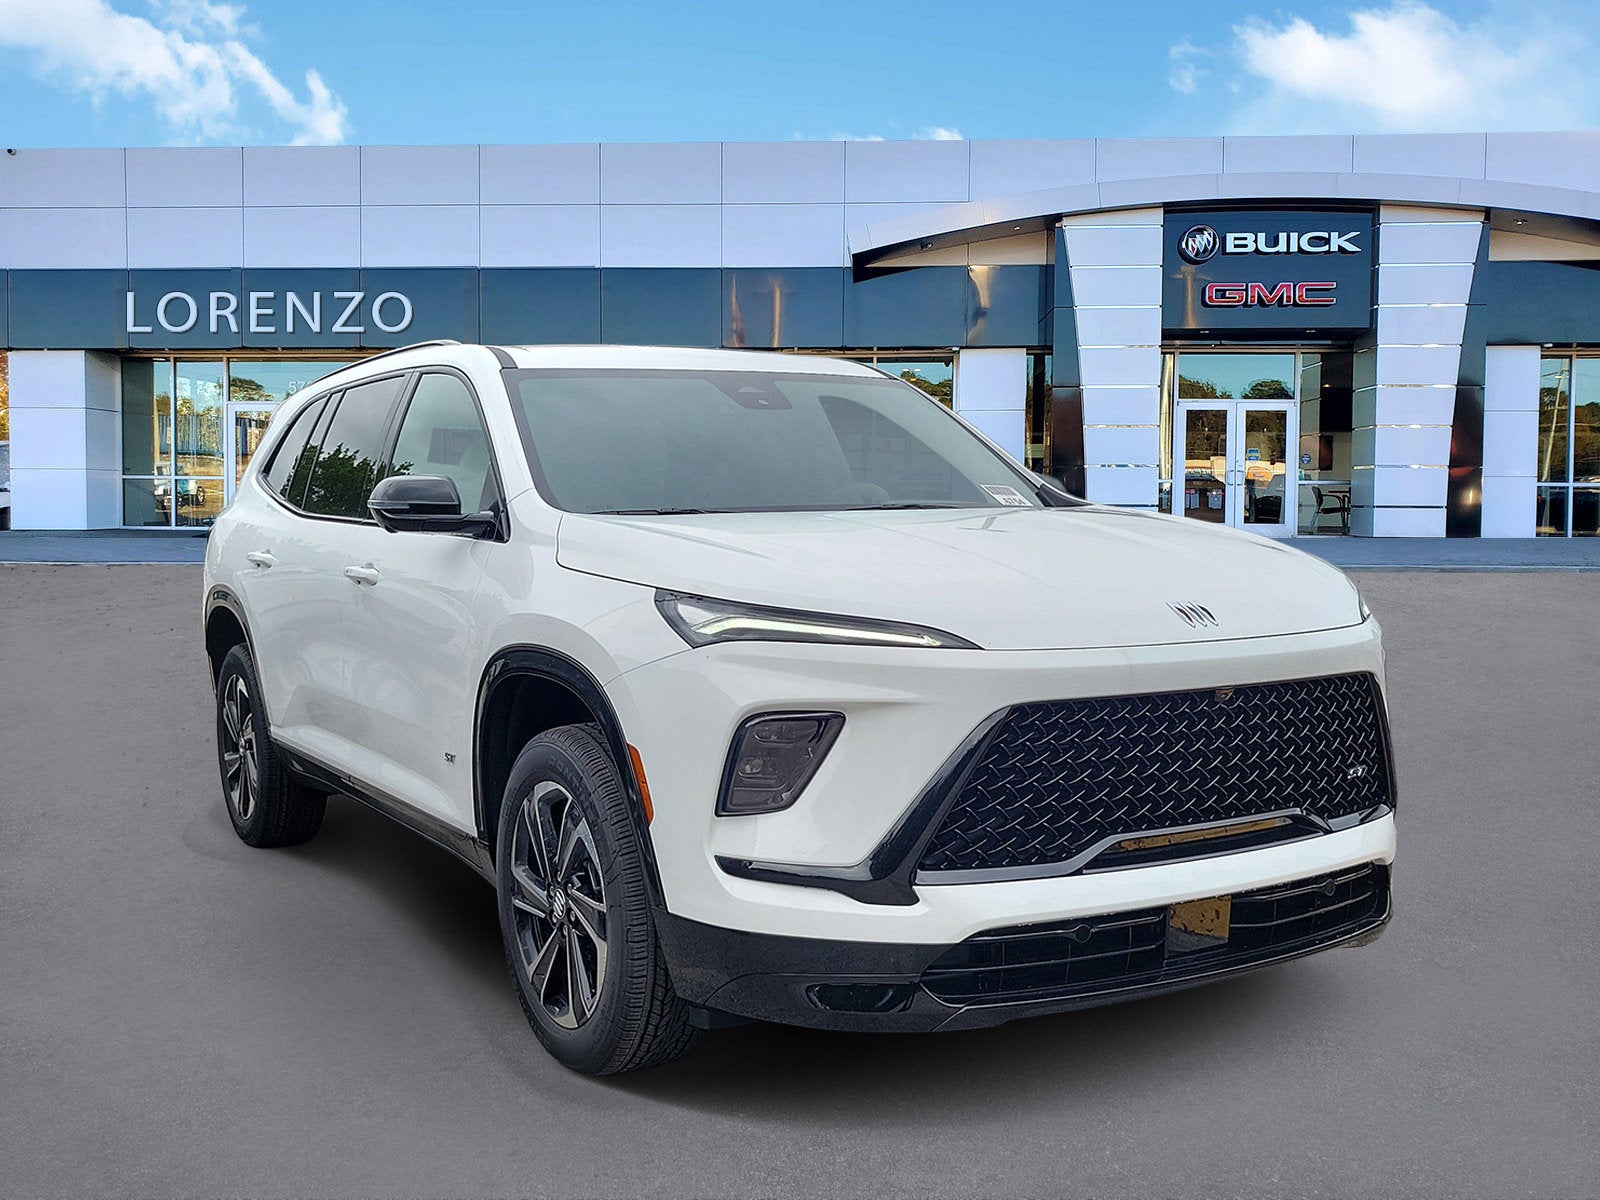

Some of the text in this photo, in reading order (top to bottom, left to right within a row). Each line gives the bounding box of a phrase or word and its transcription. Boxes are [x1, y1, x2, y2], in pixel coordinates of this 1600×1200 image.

[1225, 231, 1363, 253] BUICK
[1206, 282, 1337, 305] GMC
[126, 291, 413, 333] LORENZO
[288, 381, 309, 394] 57
